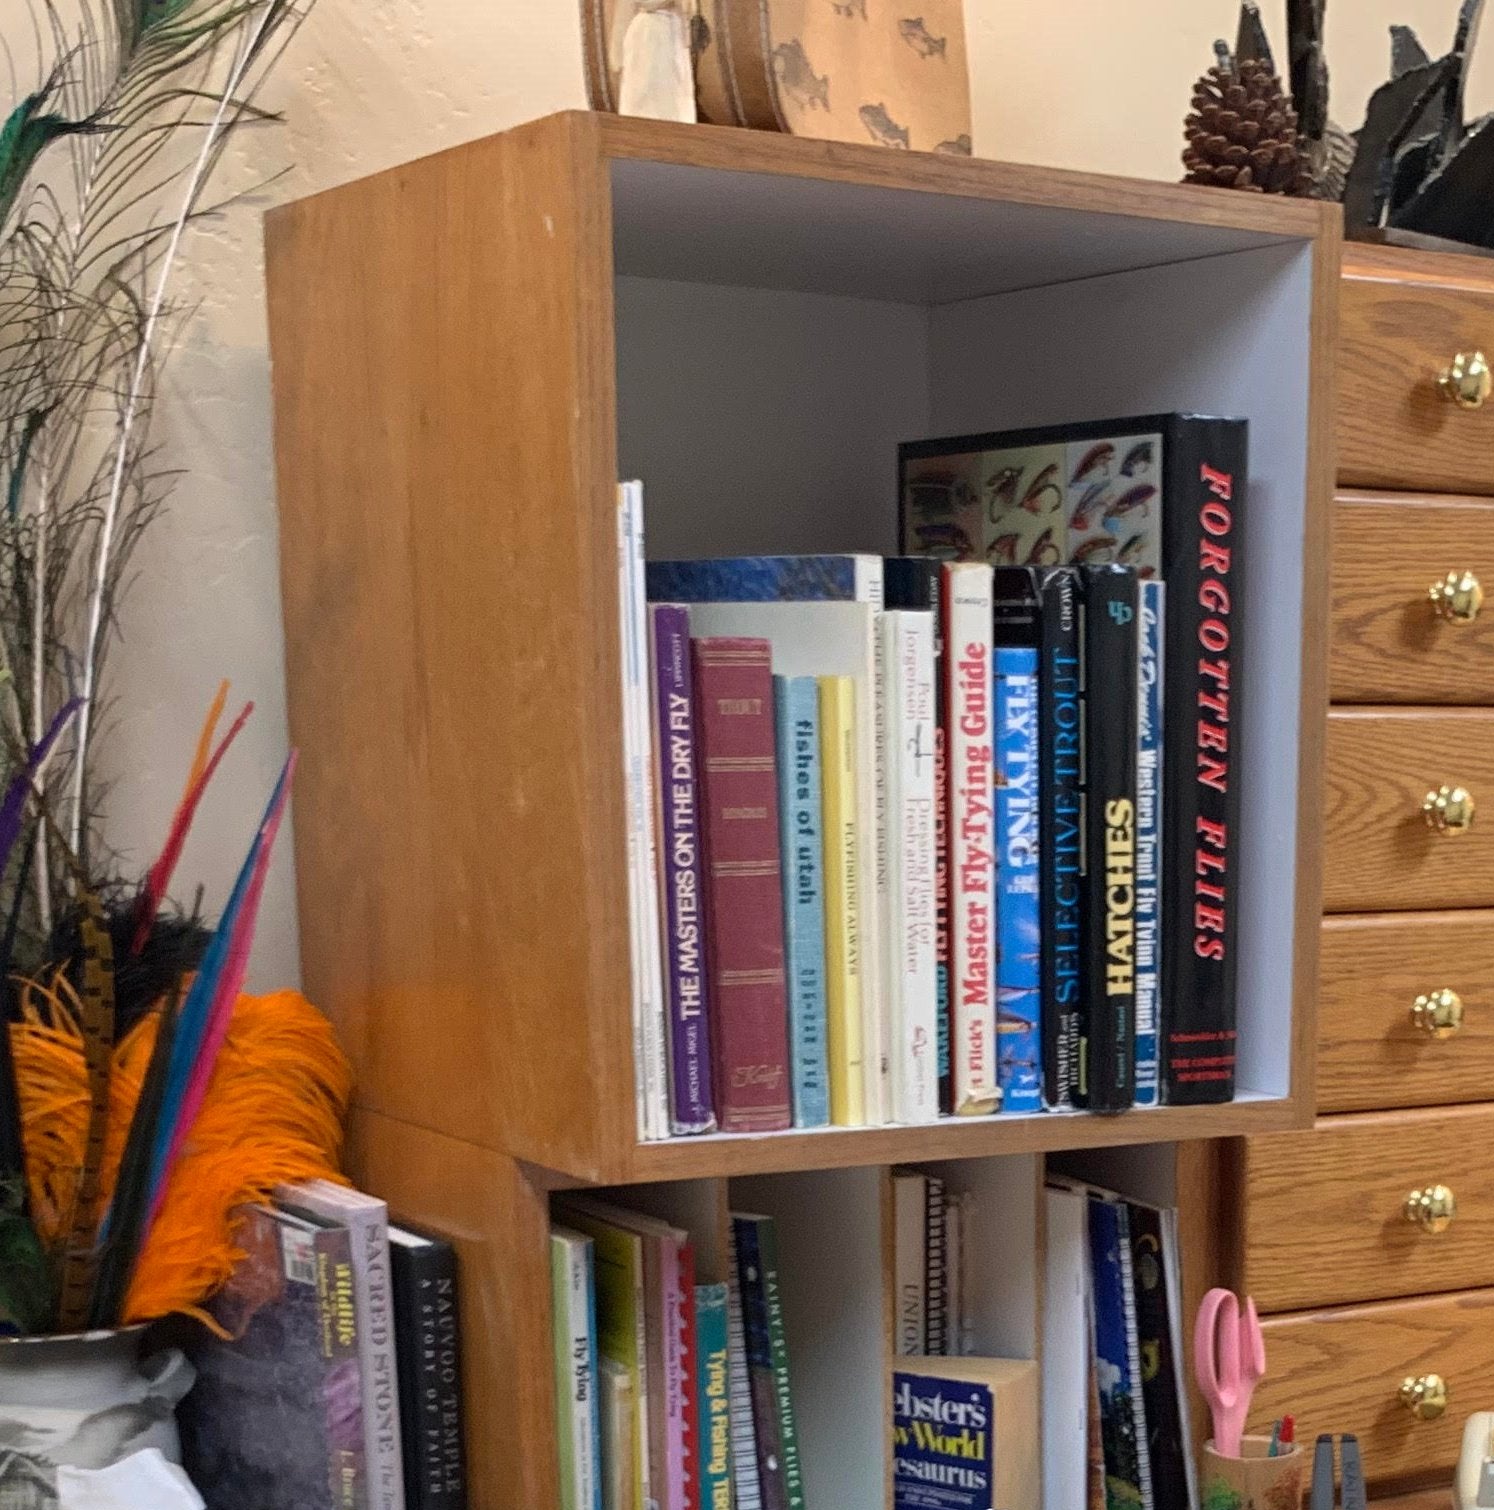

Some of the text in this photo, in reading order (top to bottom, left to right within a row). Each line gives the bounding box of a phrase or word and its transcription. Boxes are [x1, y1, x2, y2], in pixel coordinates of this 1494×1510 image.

[1056, 574, 1073, 632] CROWN
[904, 630, 920, 721] Jorgensen
[958, 642, 988, 736] Guide
[1006, 674, 1030, 737] FLY
[1193, 462, 1234, 962] FORGOTTEN FLIES
[796, 719, 817, 905] fishes of utah
[958, 745, 994, 894] Fly-Tying
[1006, 744, 1031, 868] TYING
[1136, 749, 1158, 828] Western
[669, 693, 701, 1021] THE MASTERS ON THE DRY FLY
[1053, 647, 1079, 1004] SELECTIVE TROUT
[1136, 833, 1158, 881] Trout
[845, 822, 859, 976] FLYFISHING ALWAYS
[906, 798, 921, 976] Fresh and Salt Water
[916, 798, 932, 945] Dressing Flies for
[1105, 798, 1134, 996] HATCHES
[1136, 887, 1158, 914] Fly
[962, 901, 989, 1006] Master
[1136, 919, 1158, 967] Tying
[1135, 972, 1156, 1035] Manual
[688, 1057, 700, 1103] MICHAEL
[968, 1019, 983, 1071] Flick's
[335, 1263, 356, 1345] Wildlife
[366, 1223, 395, 1454] SACRED STONE
[903, 1284, 920, 1356] UNION
[573, 1336, 588, 1361] Fly
[575, 1362, 590, 1402] Tying
[706, 1349, 728, 1397] Tying
[421, 1279, 442, 1493] A STORY OF FAITH
[437, 1278, 461, 1492] NAUVOO TEMPLE
[711, 1398, 729, 1412] &
[776, 1367, 794, 1438] PREMIUM
[895, 1382, 987, 1428] ebster's
[707, 1415, 730, 1474] Fishing
[785, 1446, 801, 1488] FLIES
[895, 1458, 987, 1490] esaurus
[912, 1420, 985, 1461] World
[789, 1496, 802, 1507] &
